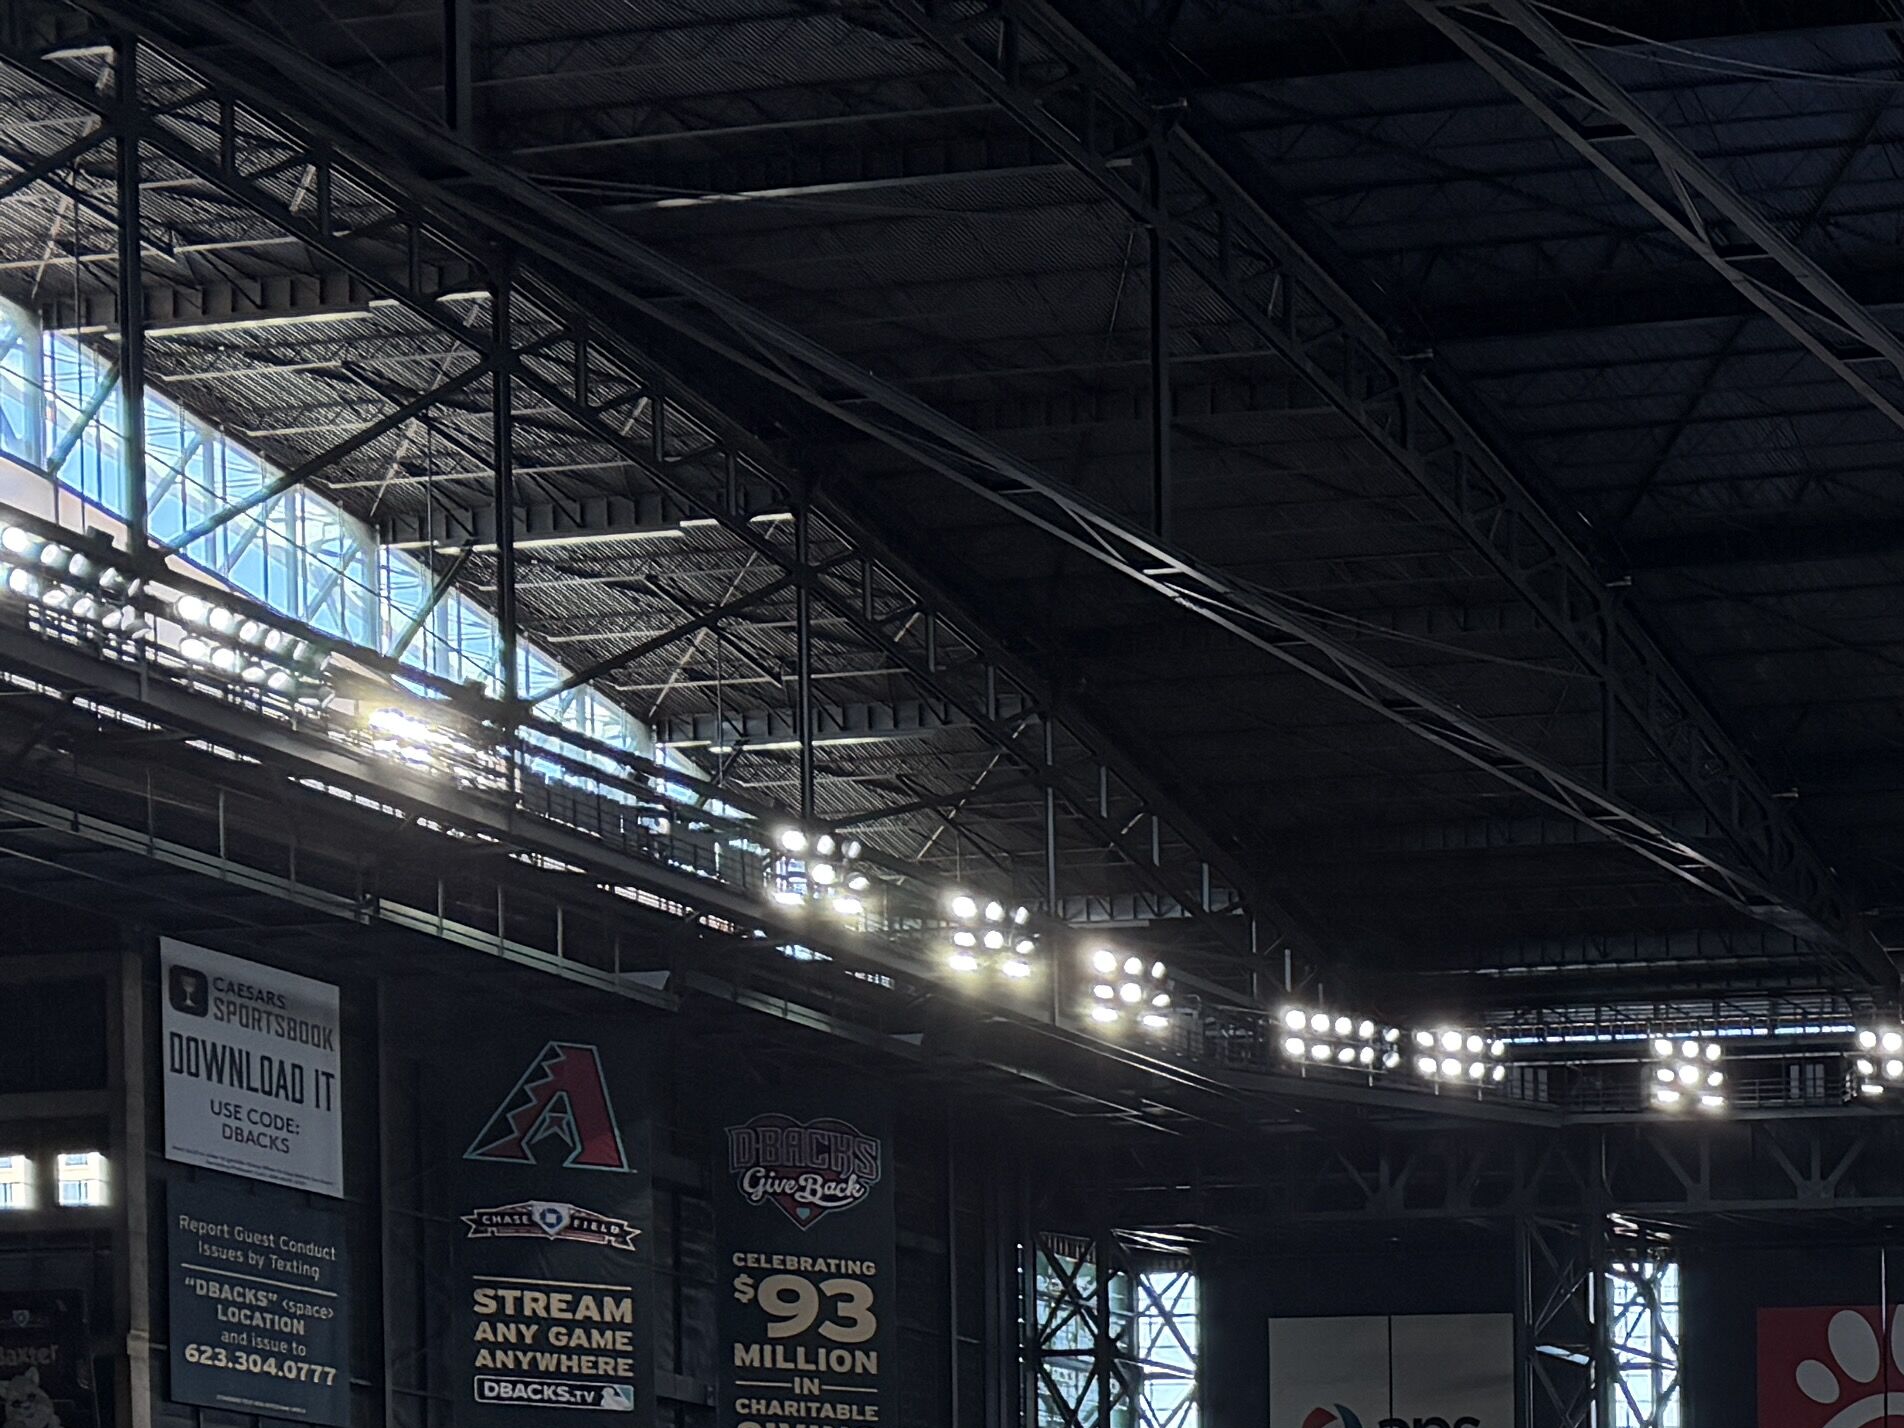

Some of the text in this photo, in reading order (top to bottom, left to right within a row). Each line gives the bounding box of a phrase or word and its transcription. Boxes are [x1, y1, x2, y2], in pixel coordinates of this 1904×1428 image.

[213, 977, 286, 1009] CAESARS
[213, 996, 334, 1052] SPORTSBOOK
[170, 1031, 335, 1112] DOWNLOAD IT
[210, 1099, 300, 1135] USE CODE:
[222, 1123, 290, 1154] DBACKS
[743, 1167, 865, 1207] Give Back
[179, 1214, 336, 1261] Report Guest Conduct
[481, 1214, 620, 1234] CHASE FIELD
[198, 1240, 320, 1281] Issues by Texting
[732, 1252, 876, 1276] CELEBRATING
[217, 1304, 305, 1335] LOCATION
[473, 1288, 633, 1323] STREAM
[733, 1273, 877, 1343] $93
[221, 1330, 307, 1357] and issue to
[474, 1321, 633, 1351] ANY GAME
[185, 1343, 337, 1386] 623.304.0777
[475, 1349, 634, 1377] ANYWHERE
[734, 1343, 878, 1374] MILLION
[484, 1380, 595, 1404] DBACKS.TV
[793, 1377, 821, 1397] IN
[735, 1398, 879, 1421] CHARITABLE
